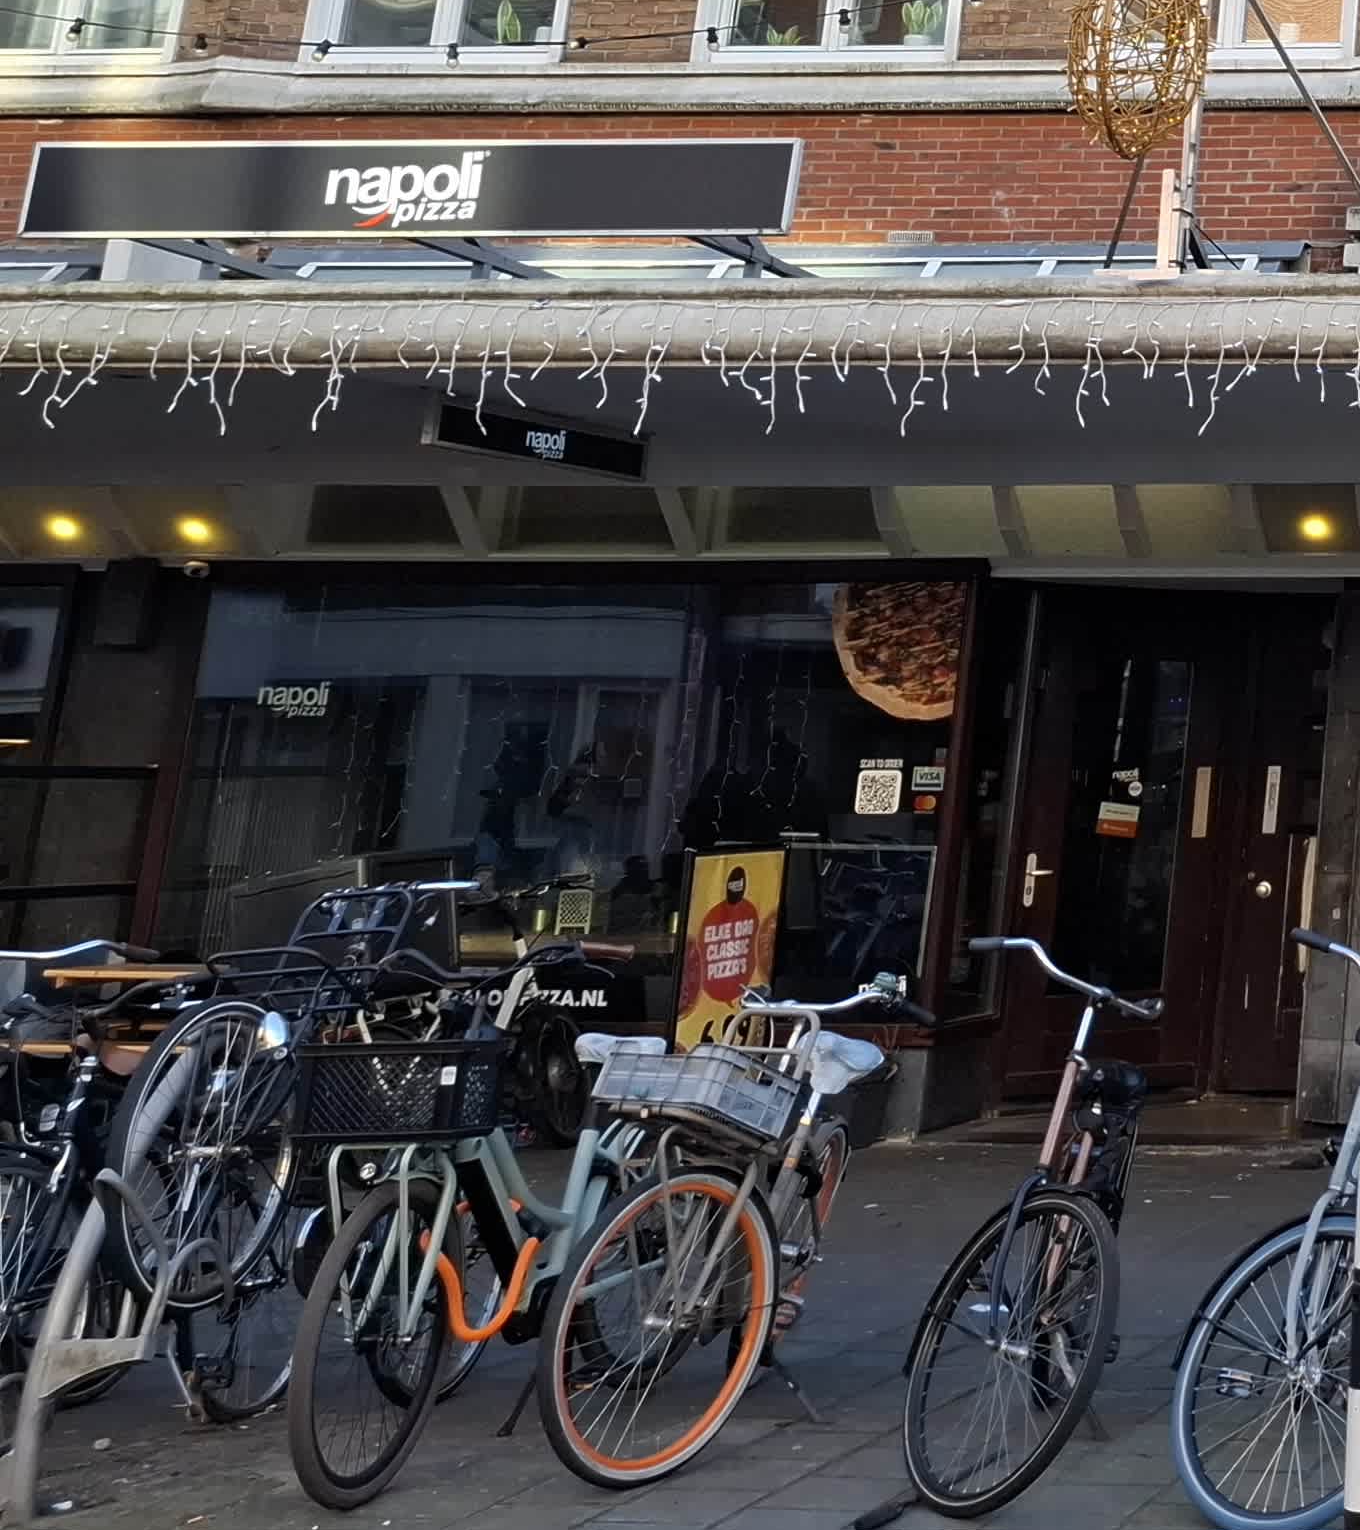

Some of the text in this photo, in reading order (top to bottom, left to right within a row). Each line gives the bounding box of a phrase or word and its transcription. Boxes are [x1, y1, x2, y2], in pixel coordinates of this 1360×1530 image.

[324, 150, 486, 214] napoli
[391, 198, 478, 228] pizza
[525, 429, 567, 454] napoli
[257, 681, 331, 710] napoli
